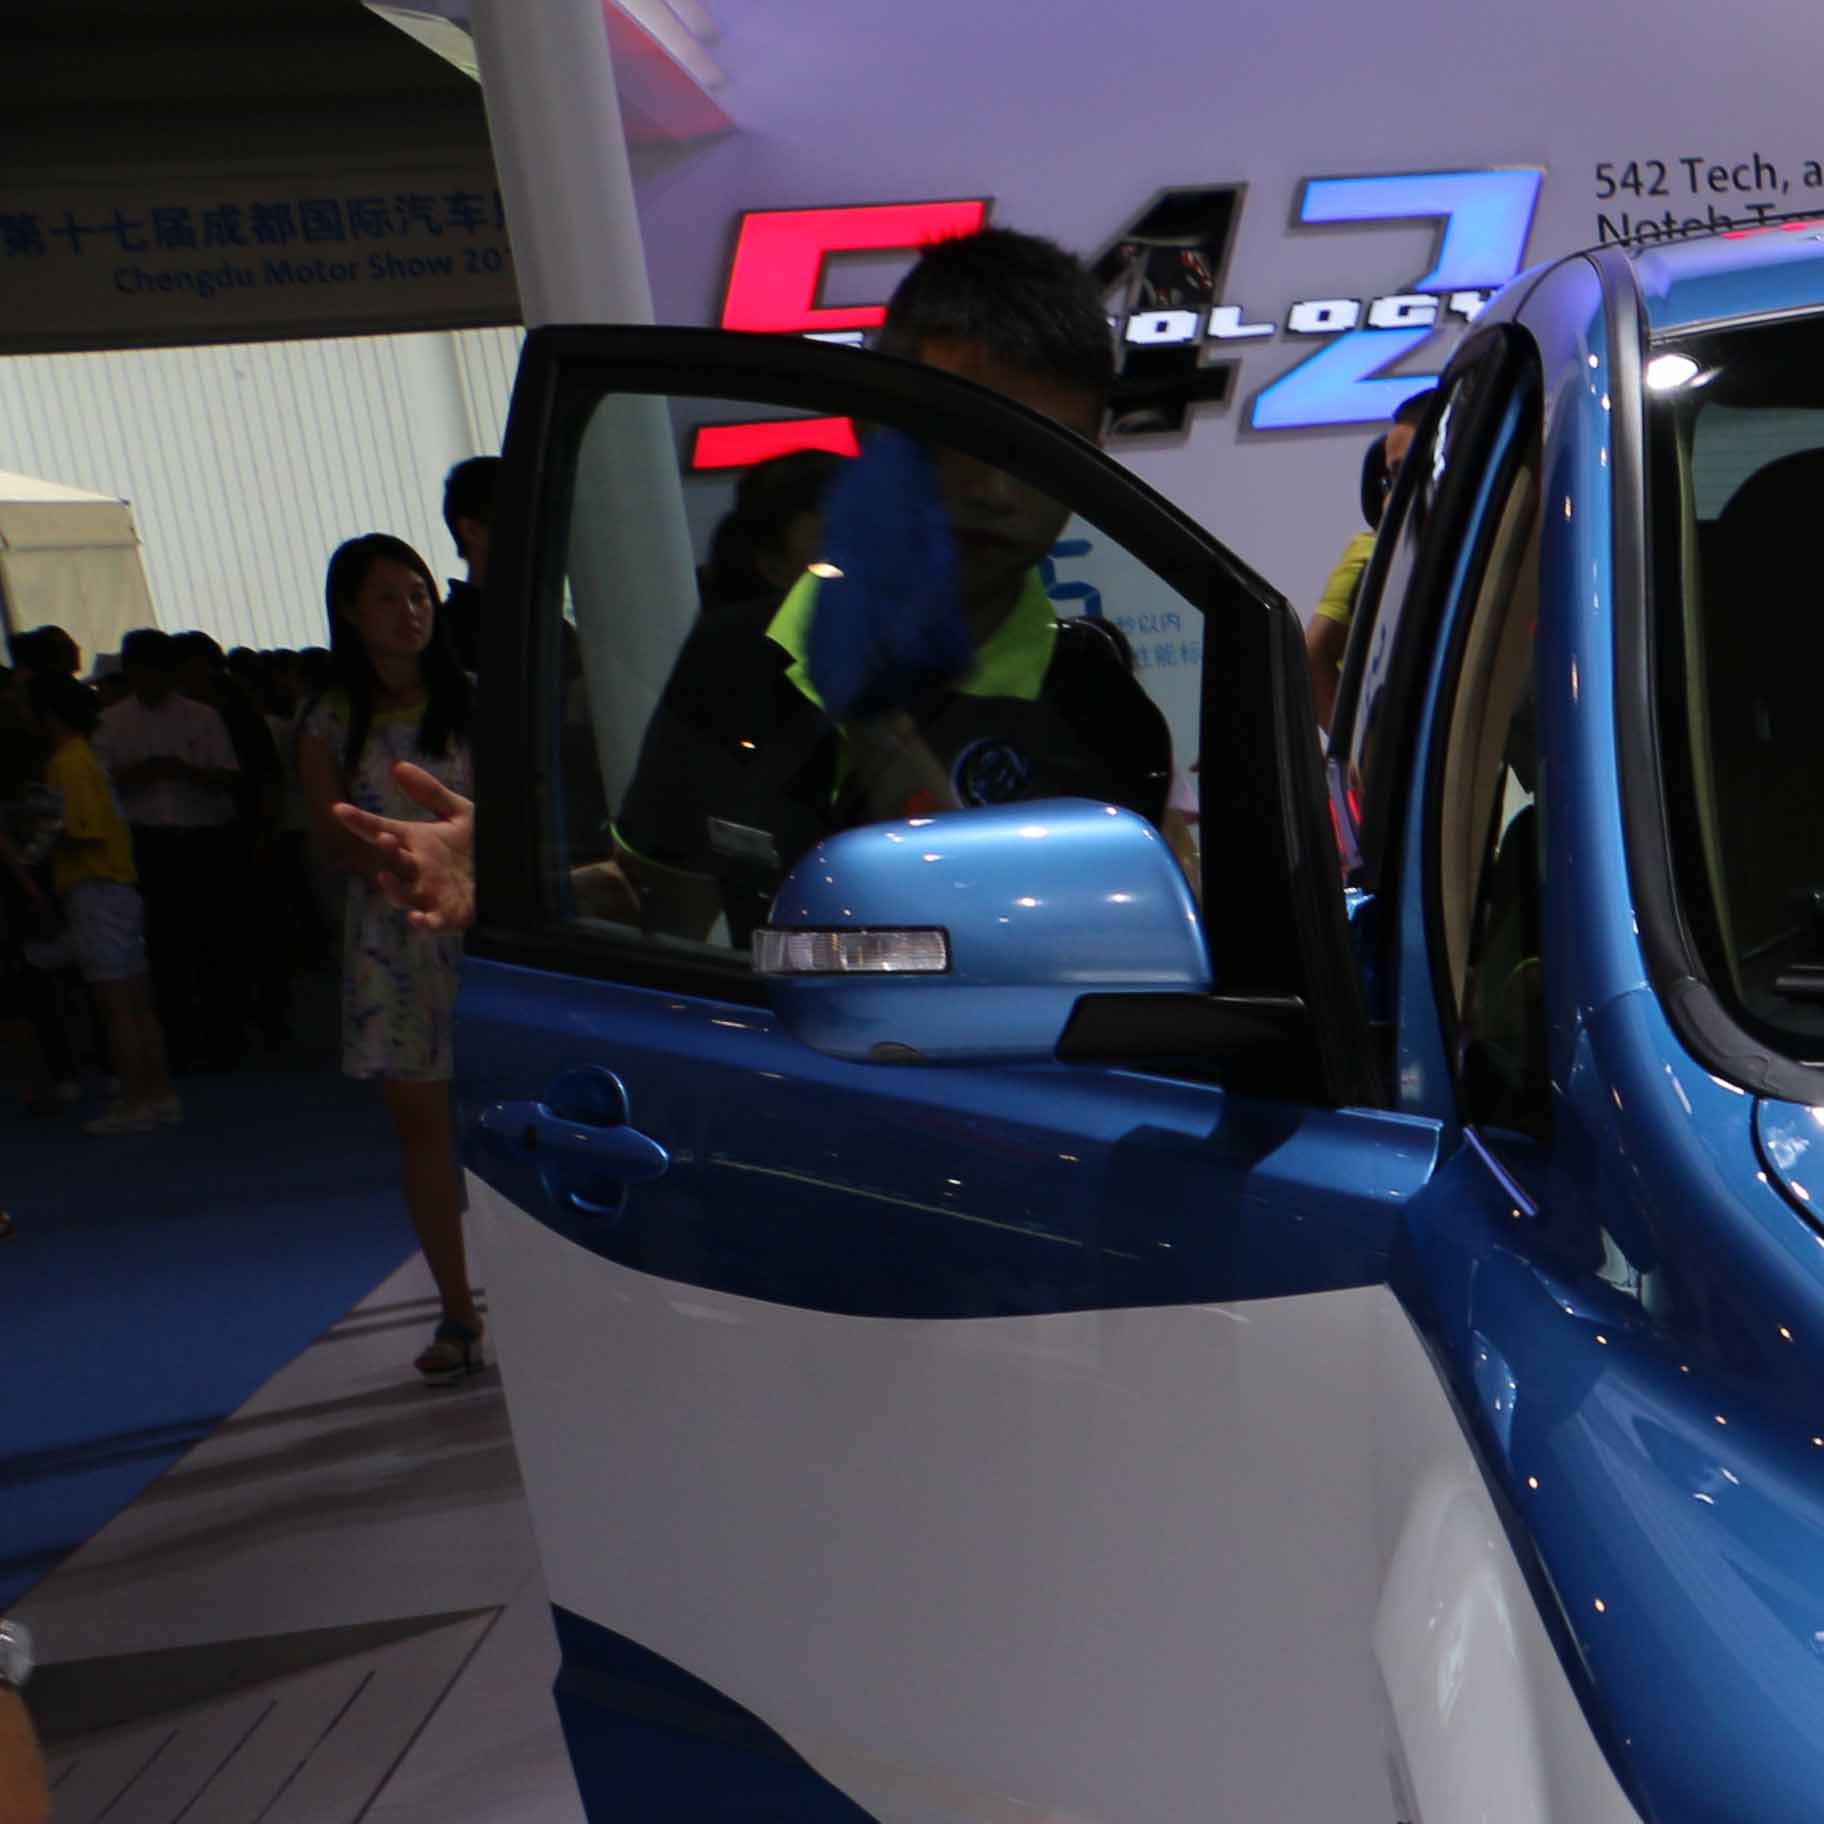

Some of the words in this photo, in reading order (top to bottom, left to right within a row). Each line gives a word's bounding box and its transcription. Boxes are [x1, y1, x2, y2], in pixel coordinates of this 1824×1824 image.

[1596, 159, 1669, 200] 542
[1680, 153, 1790, 195] Tech,
[1803, 161, 1824, 187] a
[2, 191, 504, 257] 第十七届成都国际汽车
[115, 260, 254, 297] Chengdu
[265, 257, 360, 287] Motor
[368, 251, 454, 279] Show
[463, 247, 512, 274] 20
